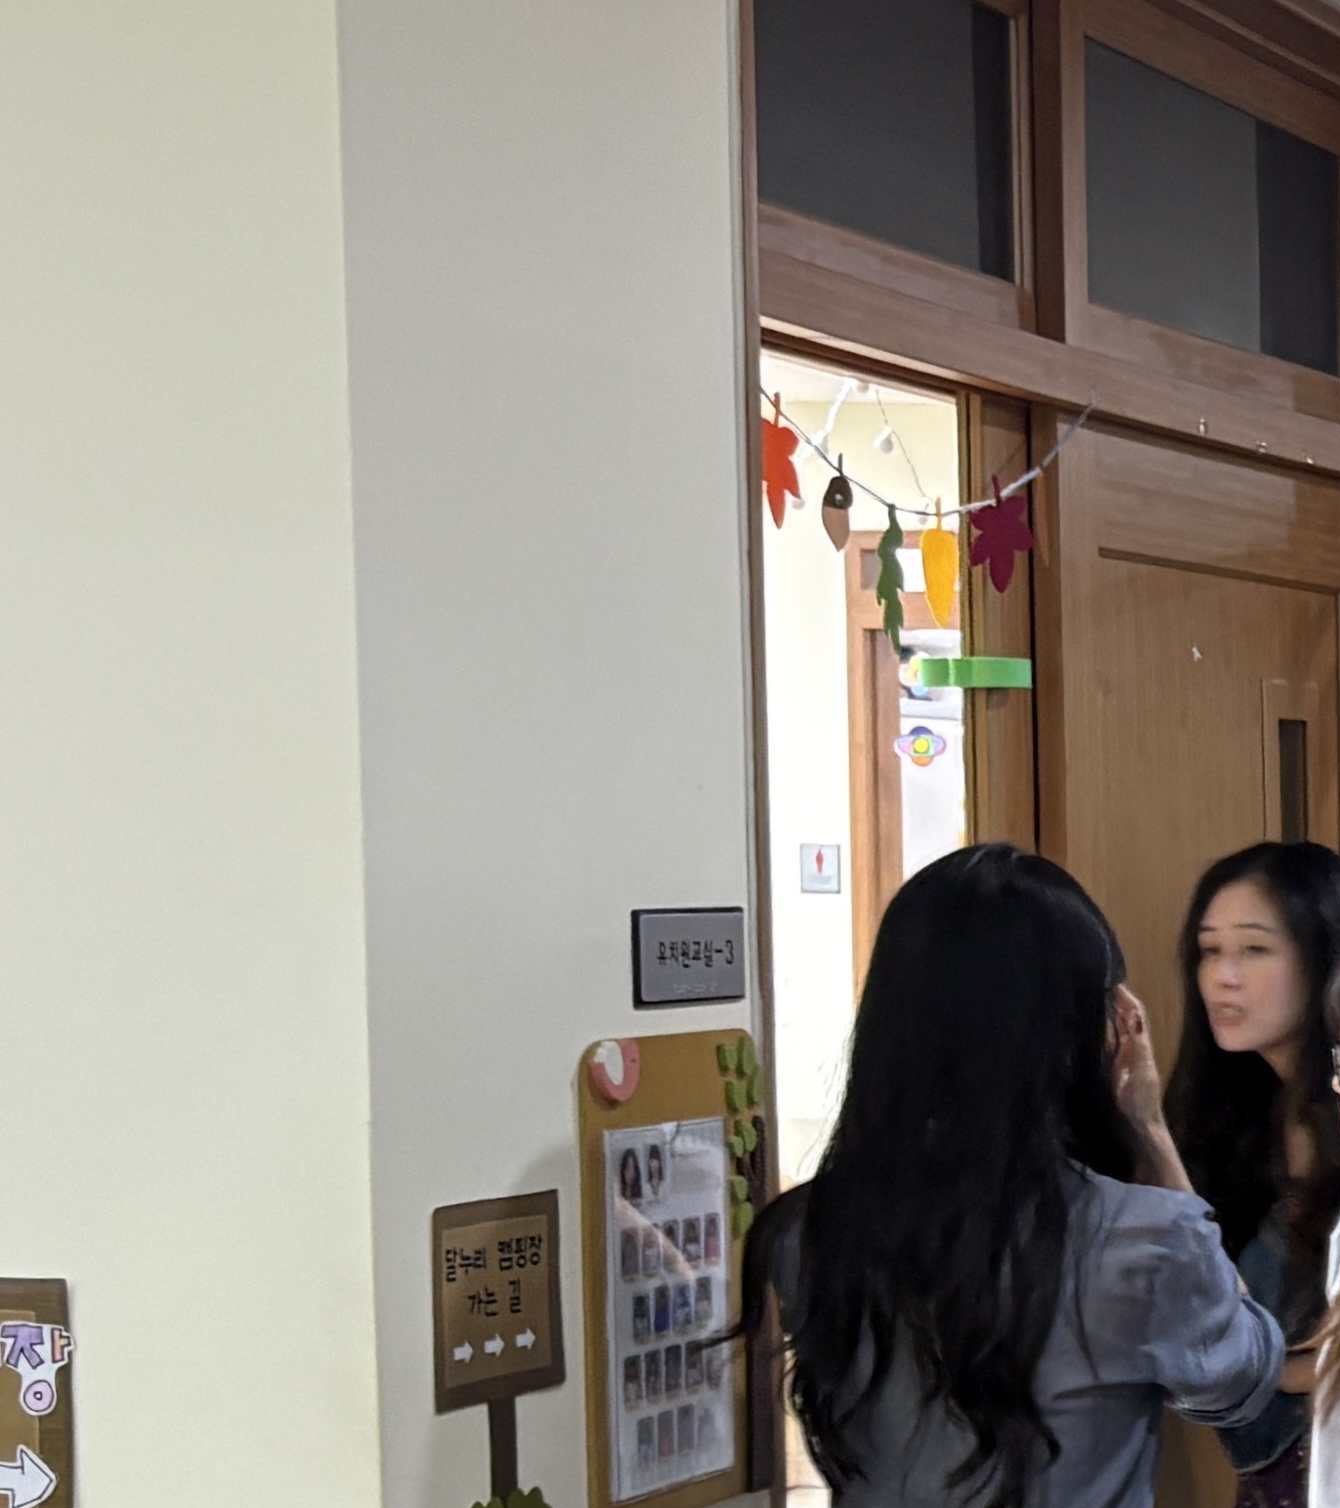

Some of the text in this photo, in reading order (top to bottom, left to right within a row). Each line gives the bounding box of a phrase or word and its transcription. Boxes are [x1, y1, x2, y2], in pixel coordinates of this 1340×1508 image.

[446, 1247, 487, 1282] 달누리
[468, 1278, 522, 1317] 가는 길
[0, 1324, 72, 1413] 장
